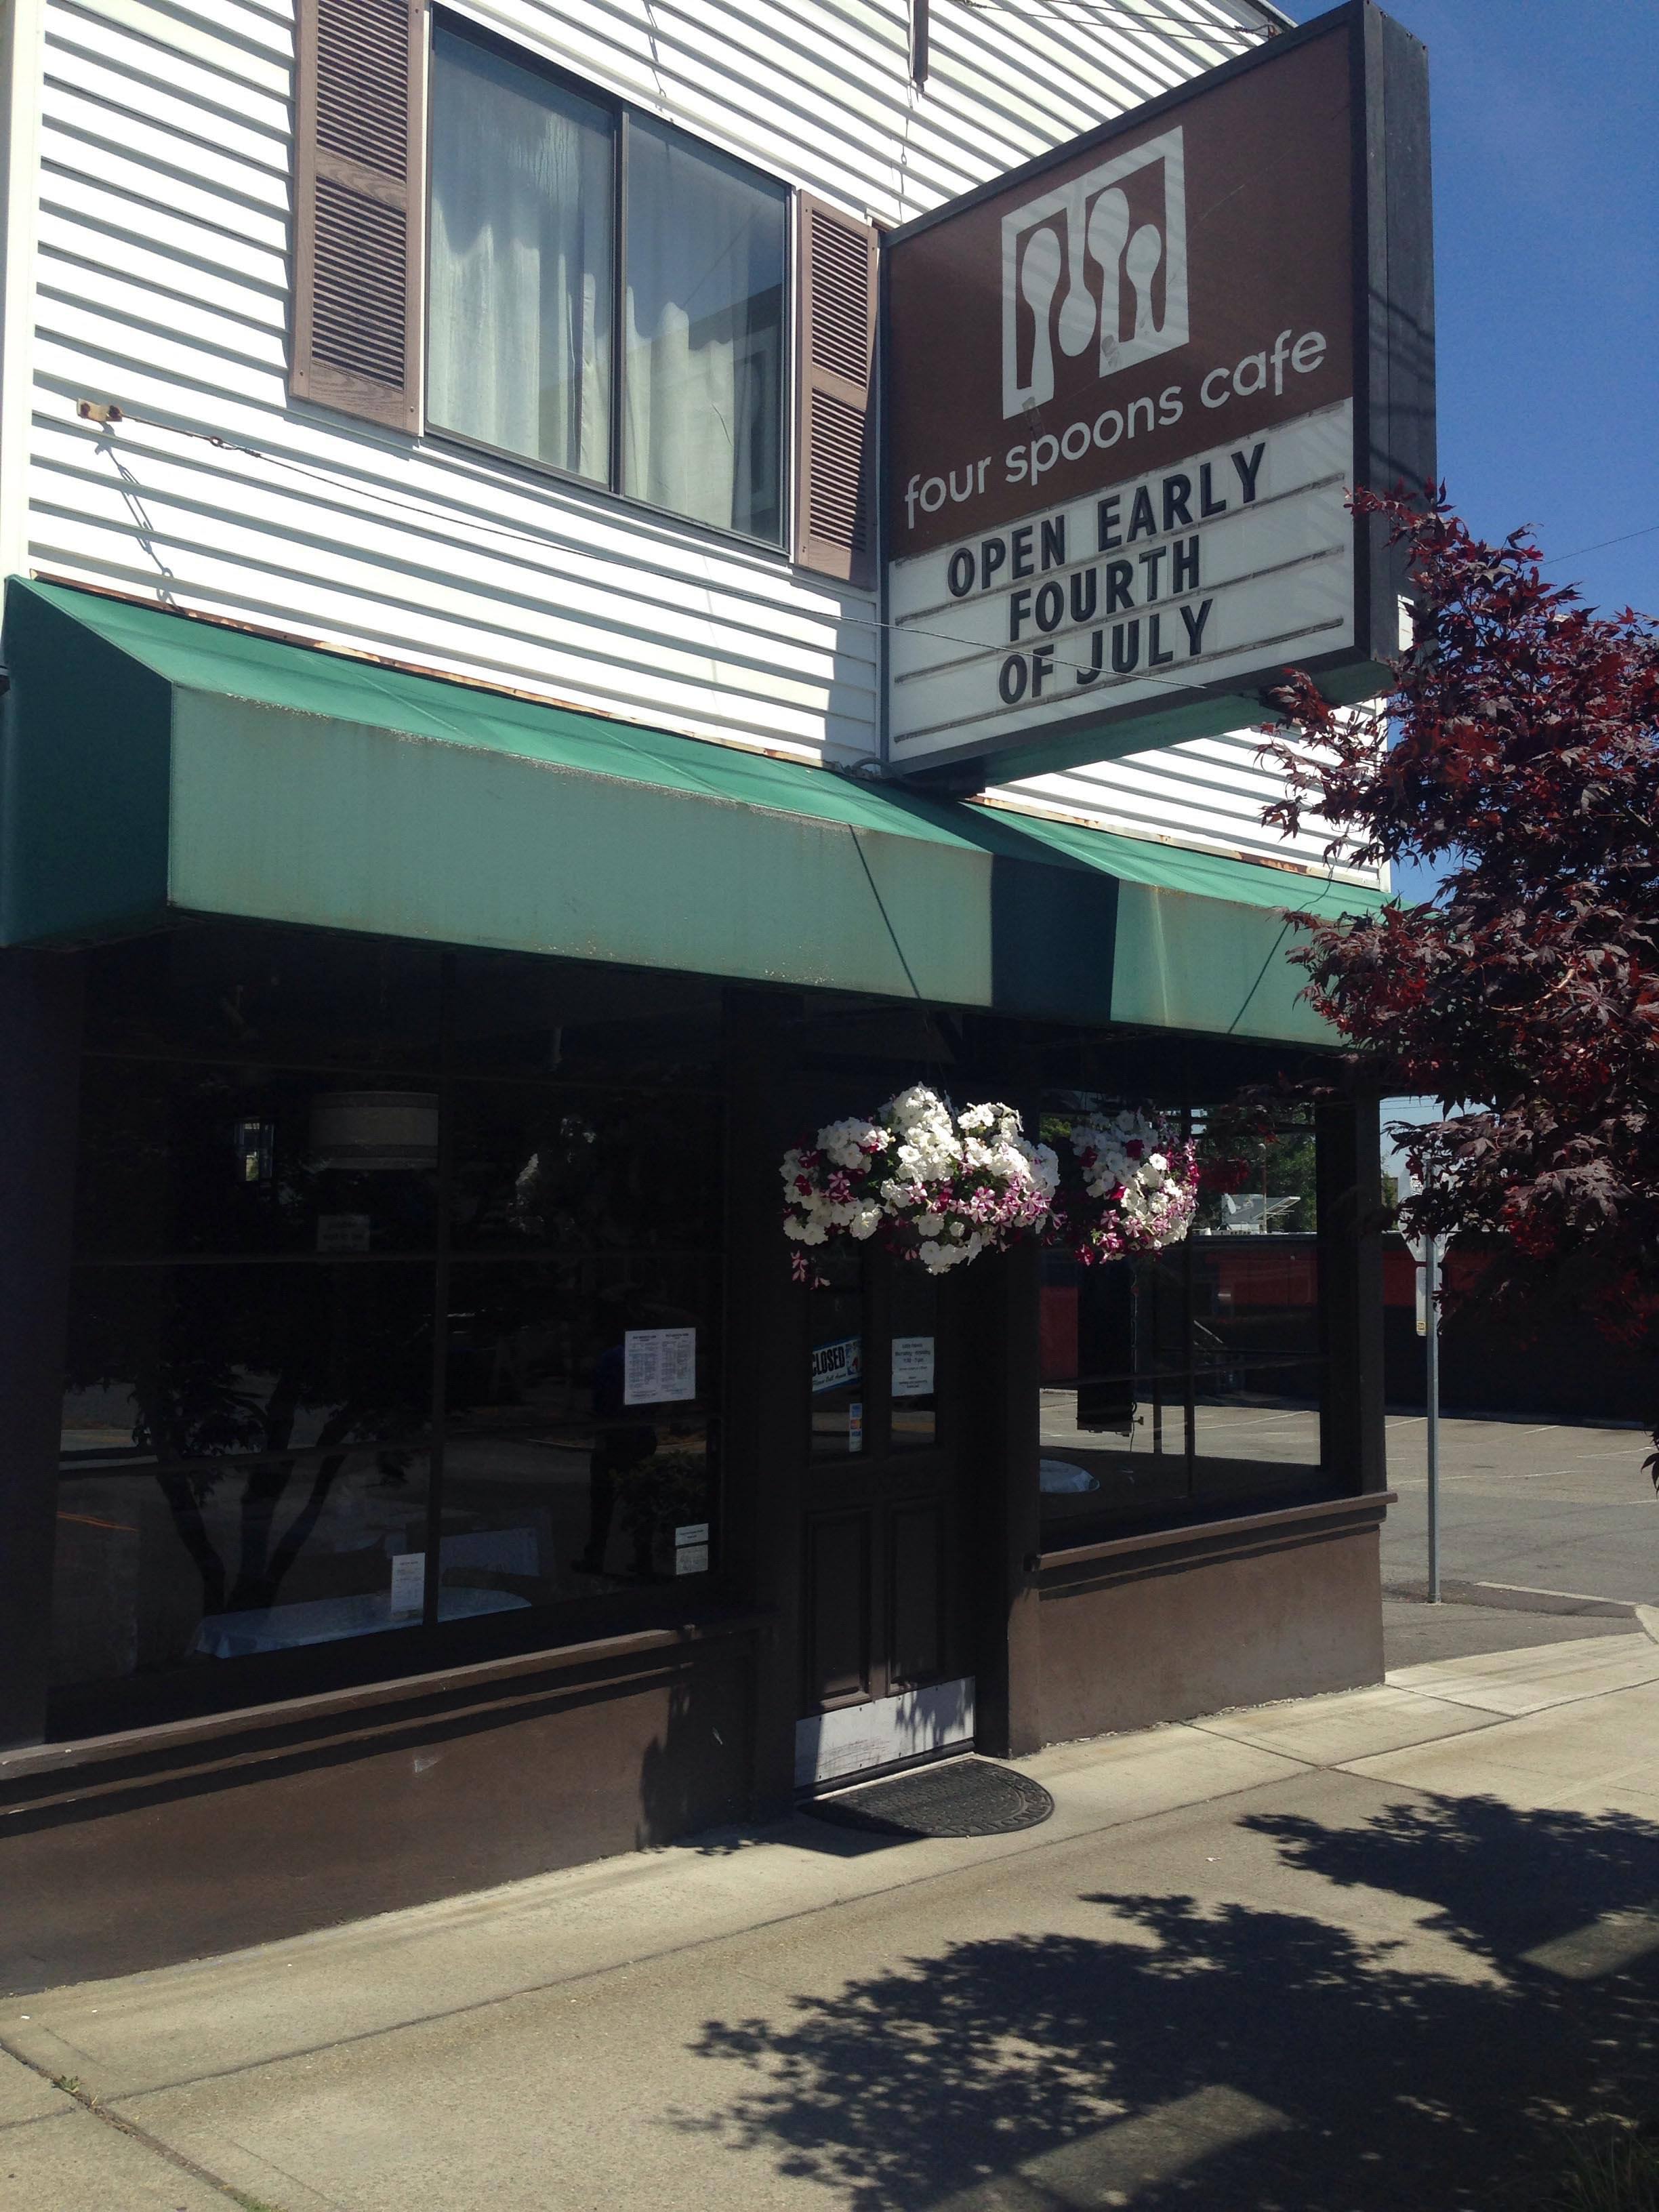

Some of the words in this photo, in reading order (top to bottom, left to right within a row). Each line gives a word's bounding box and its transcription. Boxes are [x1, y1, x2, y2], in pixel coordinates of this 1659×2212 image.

[905, 456, 991, 529] four
[1005, 386, 1183, 486] spoons
[1200, 329, 1327, 408] cafe
[948, 514, 1065, 598] OPEN
[1097, 443, 1265, 552] EARLY
[999, 644, 1054, 705] OF
[1076, 598, 1213, 685] JULY
[1010, 535, 1199, 642] FOURTH
